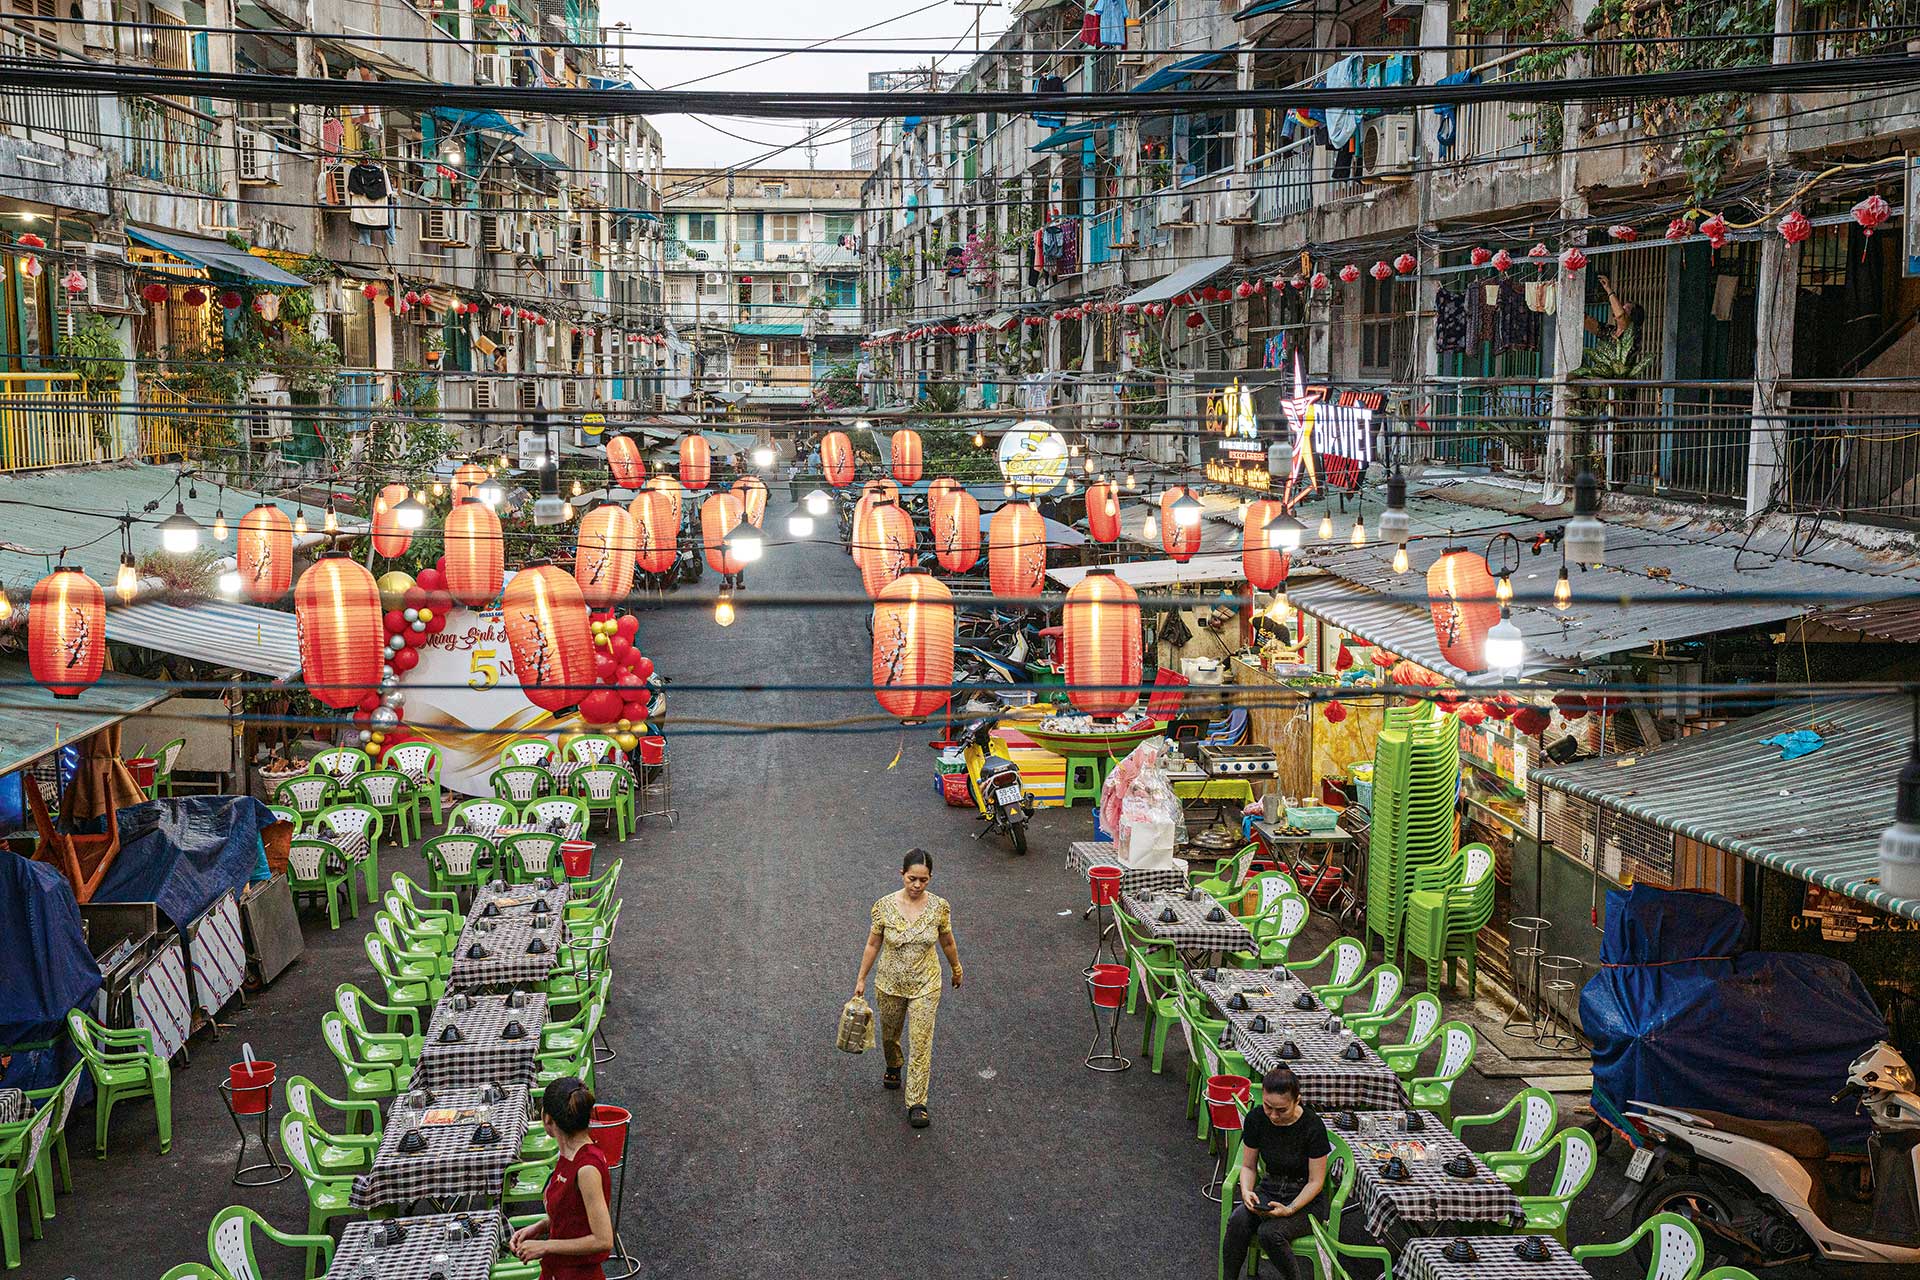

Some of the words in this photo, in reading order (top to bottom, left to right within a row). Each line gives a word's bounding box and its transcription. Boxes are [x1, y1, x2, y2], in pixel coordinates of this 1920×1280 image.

[1313, 403, 1341, 456] BIA
[1336, 399, 1373, 470] VIỆT
[460, 625, 495, 645] Sinh
[468, 649, 499, 691] 5
[1688, 1129, 1734, 1145] VISION
